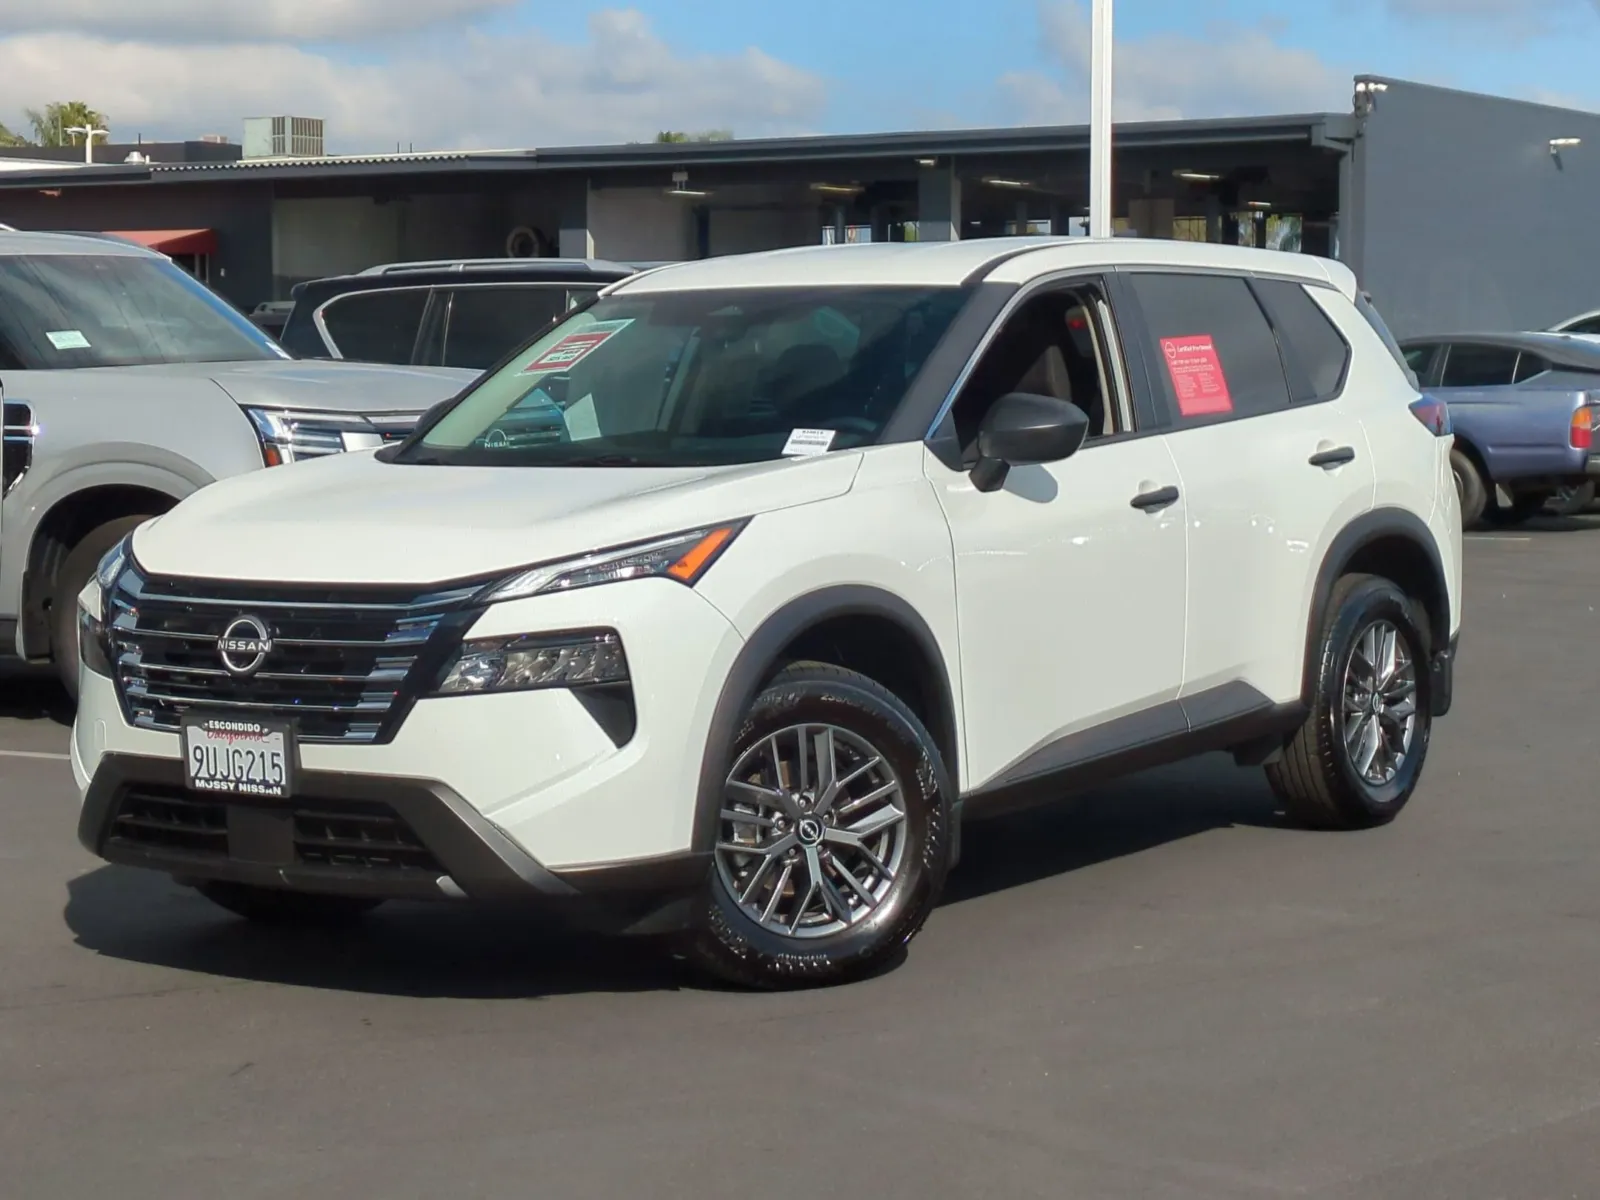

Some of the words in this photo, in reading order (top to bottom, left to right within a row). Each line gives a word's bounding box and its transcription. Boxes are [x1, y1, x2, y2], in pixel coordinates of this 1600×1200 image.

[217, 639, 272, 652] NISSAN
[208, 720, 261, 732] ESCONDIDO
[193, 745, 283, 784] 9UJG215
[195, 779, 236, 791] MOSSY
